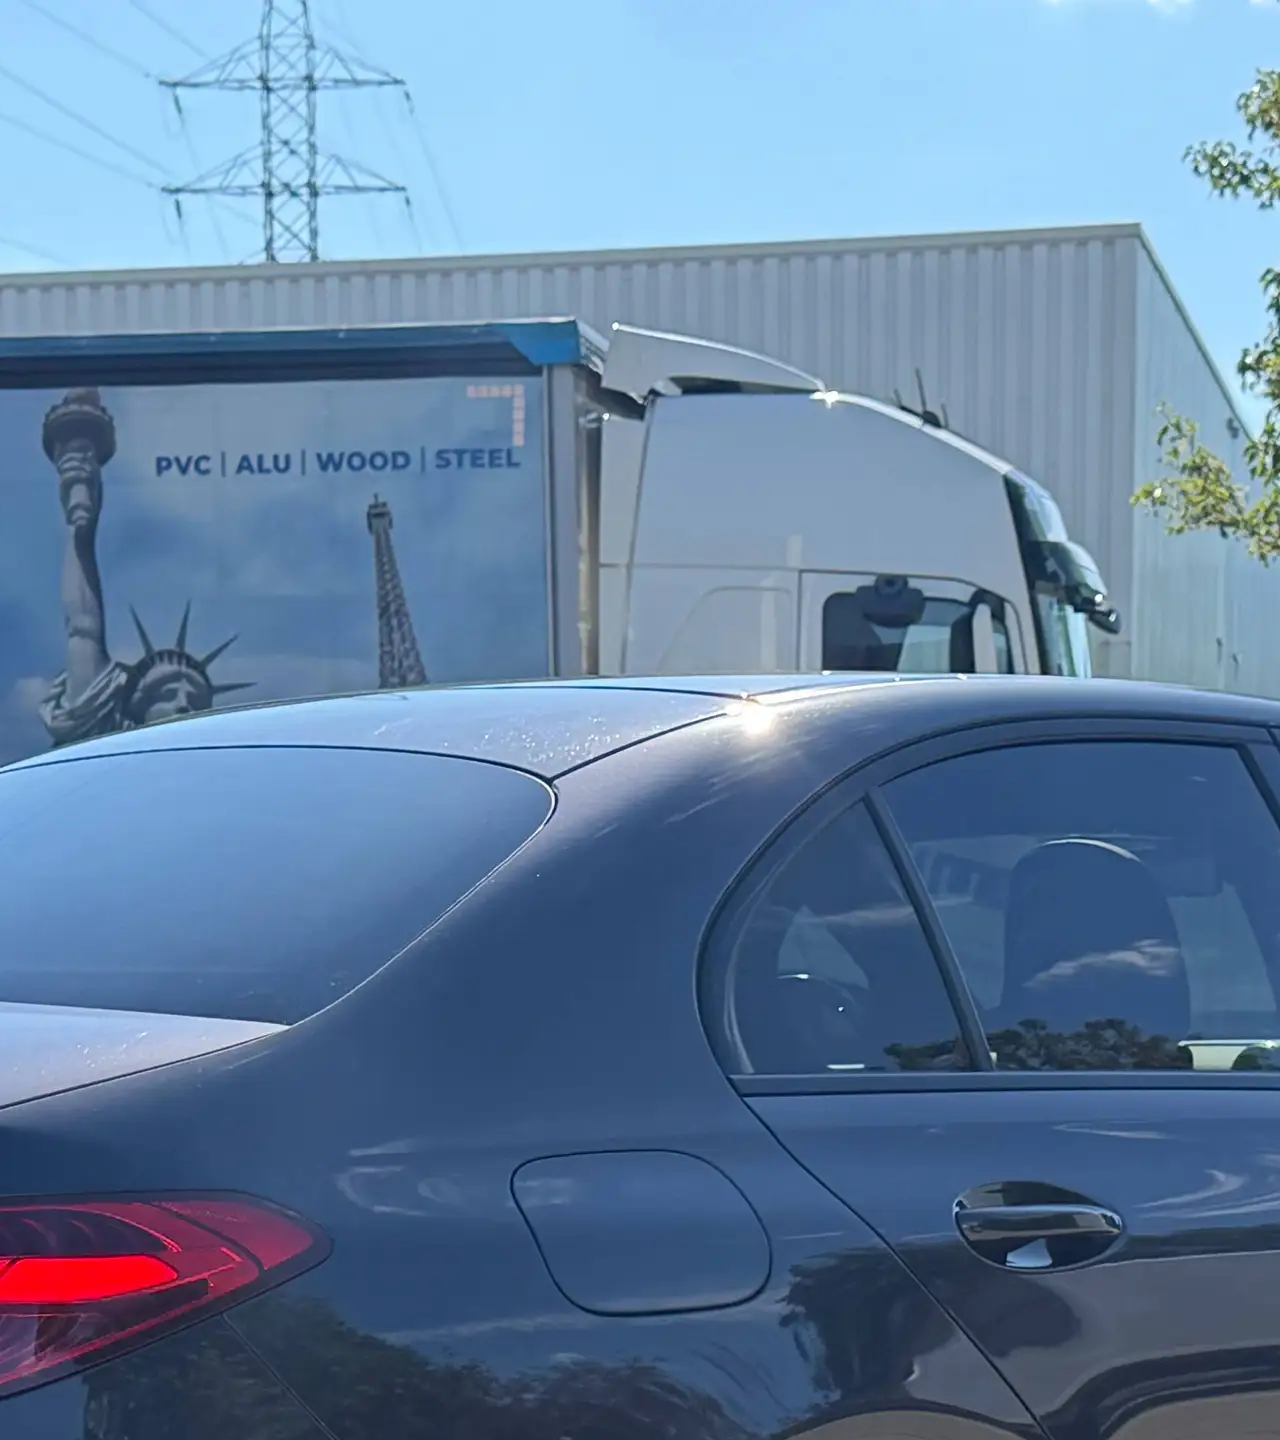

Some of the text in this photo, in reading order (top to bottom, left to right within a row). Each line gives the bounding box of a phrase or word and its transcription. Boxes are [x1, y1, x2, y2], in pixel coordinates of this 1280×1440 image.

[156, 447, 522, 477] PVC ALU WOOD STEEL
